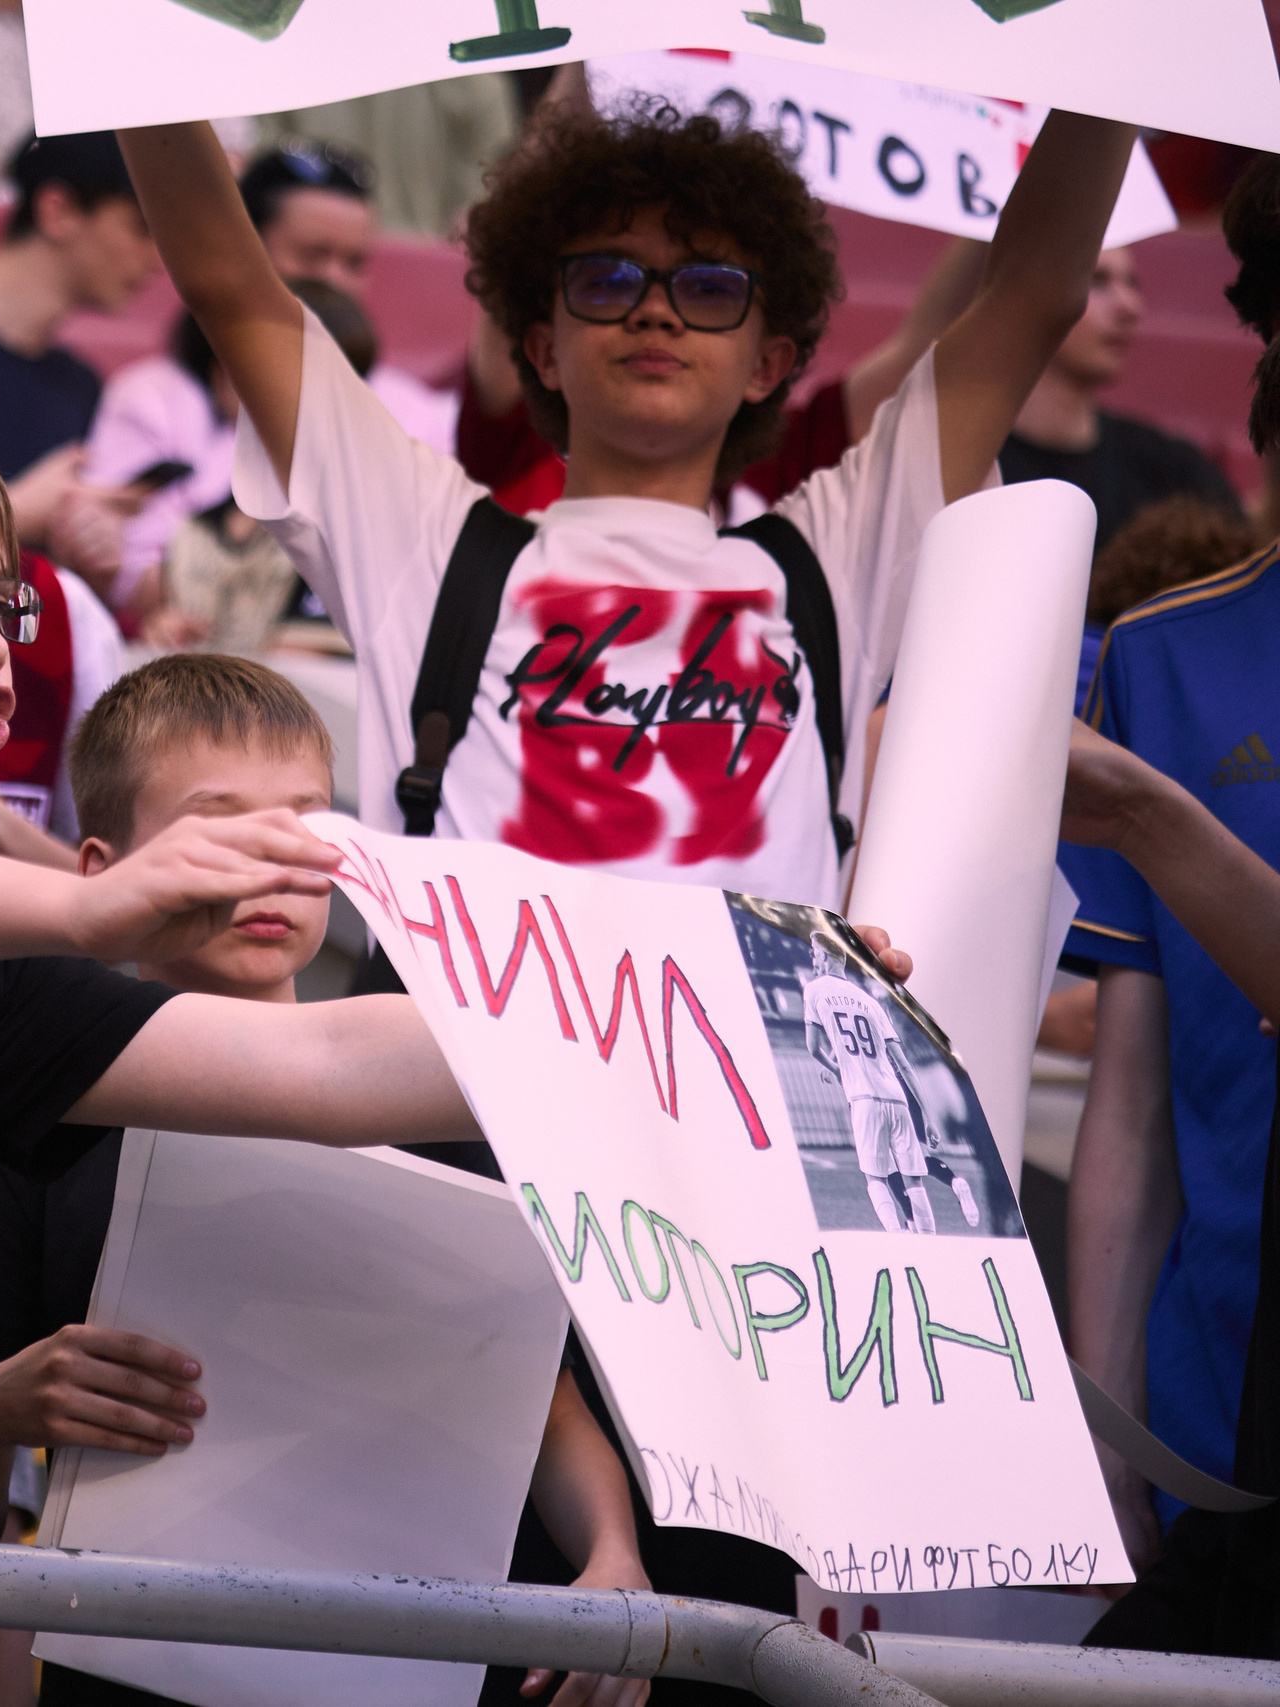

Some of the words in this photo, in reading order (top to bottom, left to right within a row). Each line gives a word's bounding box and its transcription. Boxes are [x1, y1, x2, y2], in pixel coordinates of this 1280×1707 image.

[825, 996, 869, 1014] МОТОРИН
[833, 1011, 877, 1060] 59
[520, 1181, 1035, 1408] МОТОРИН
